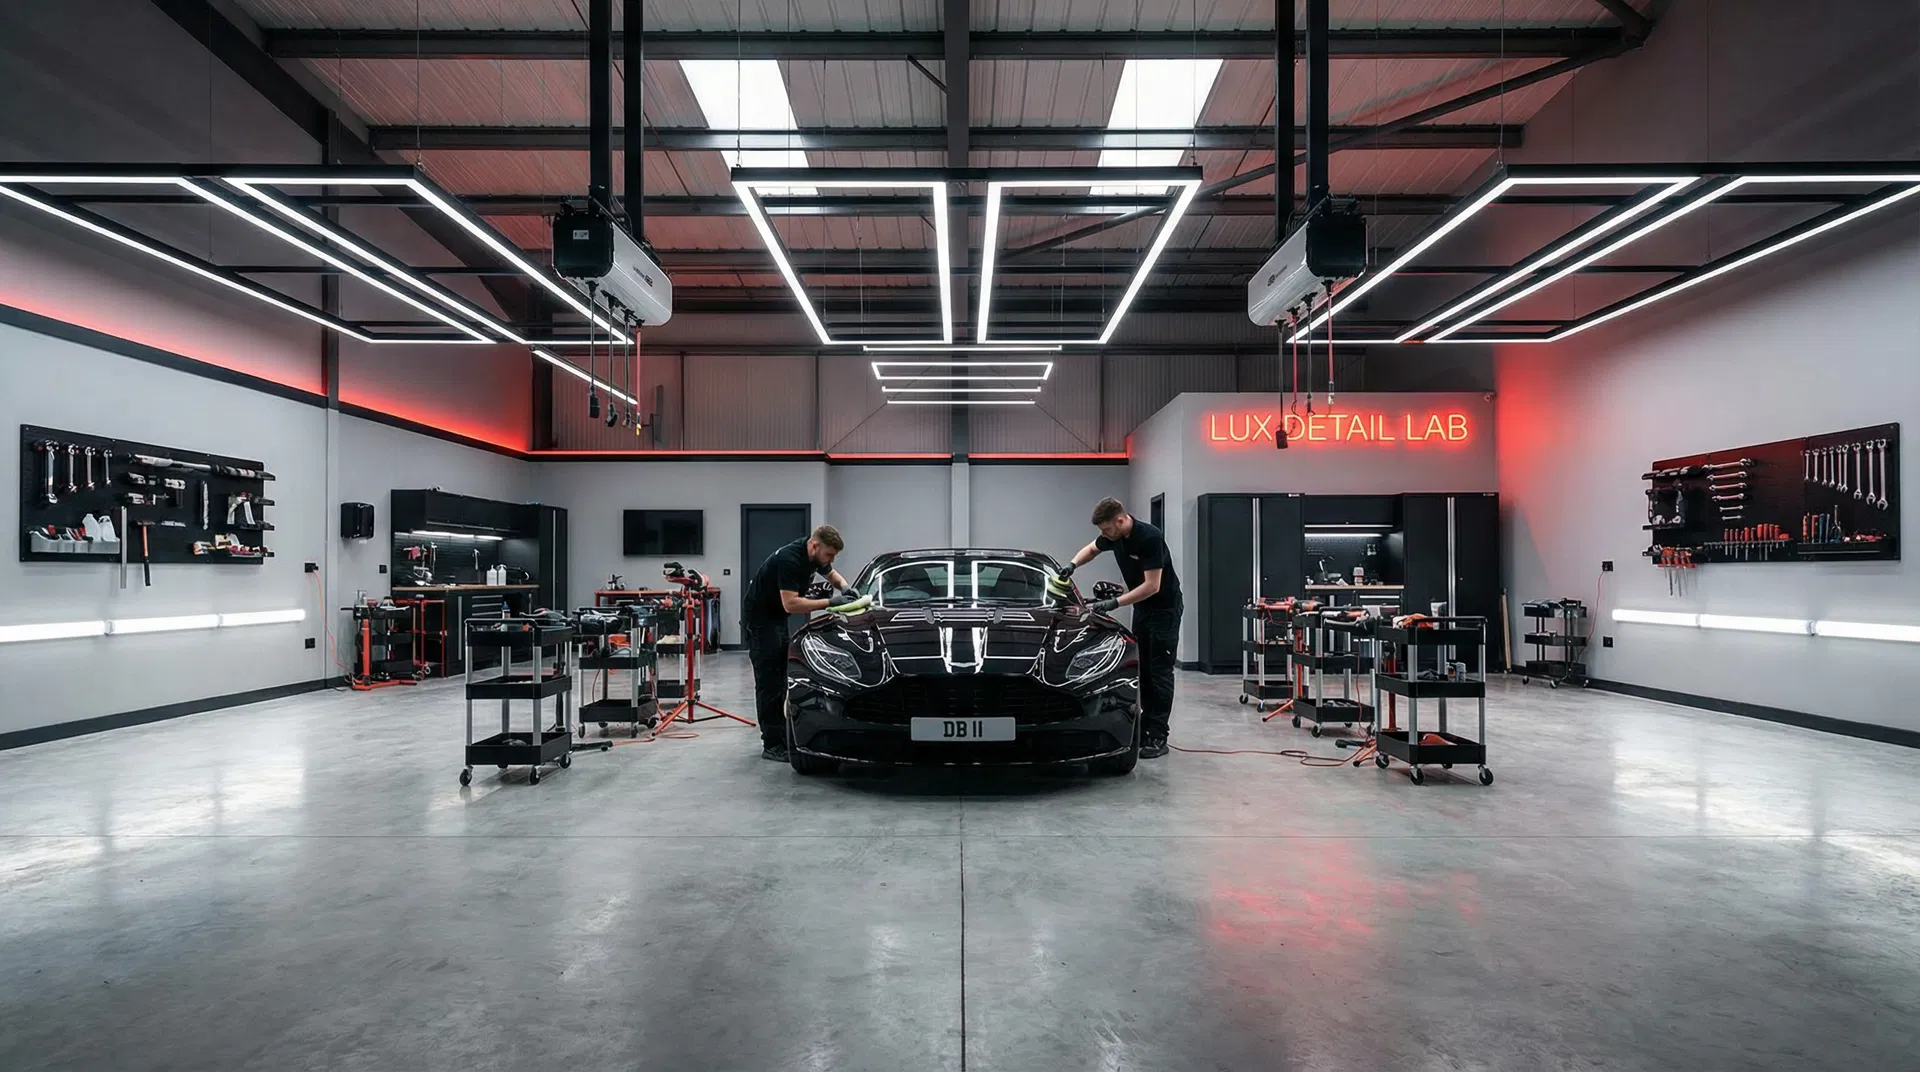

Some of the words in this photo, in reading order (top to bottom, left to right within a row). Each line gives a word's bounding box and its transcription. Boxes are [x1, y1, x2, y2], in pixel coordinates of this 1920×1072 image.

[1211, 413, 1273, 441] LUX
[1284, 413, 1395, 441] DETAIL
[1406, 413, 1469, 441] LAB
[943, 720, 968, 738] DB
